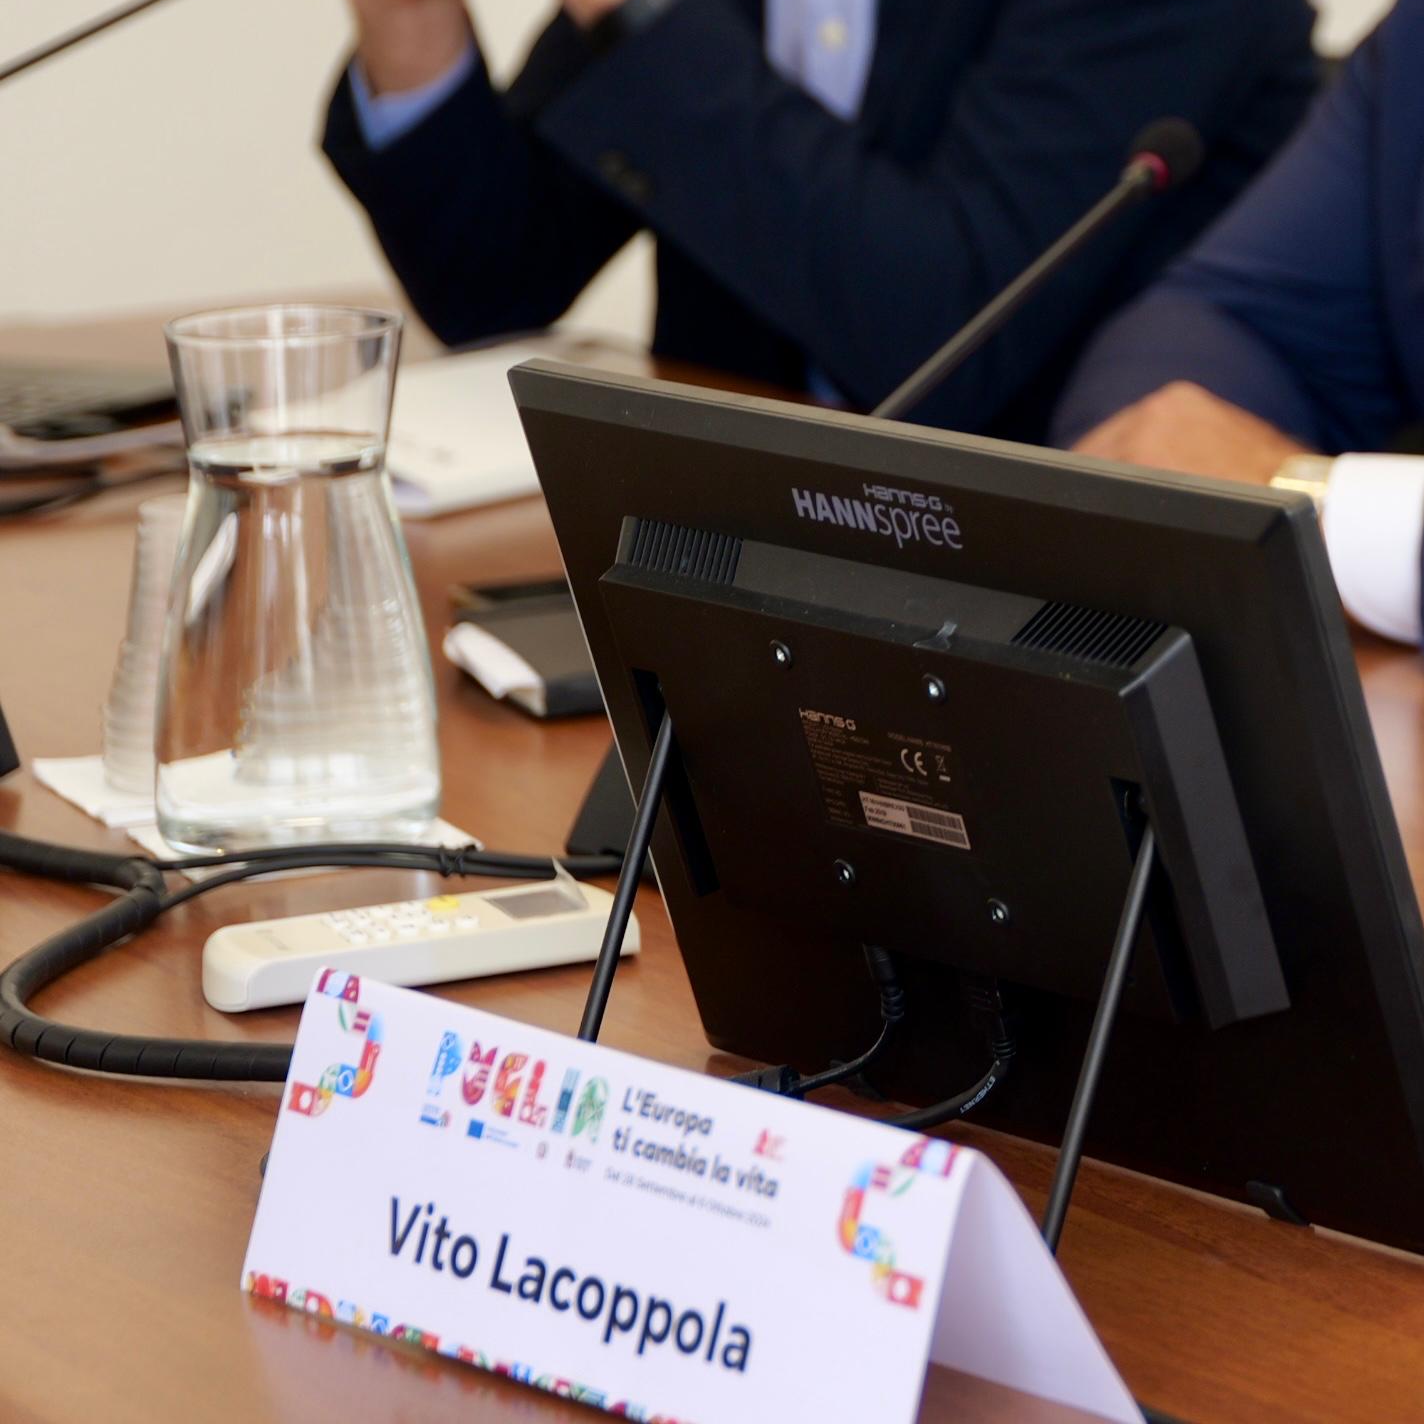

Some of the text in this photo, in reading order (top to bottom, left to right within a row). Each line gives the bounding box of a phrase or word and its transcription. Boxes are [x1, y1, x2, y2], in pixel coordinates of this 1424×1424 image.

[791, 487, 963, 549] HANNspree
[622, 1085, 714, 1136] L'Europa
[612, 1127, 779, 1198] ti cambia la vita
[389, 1195, 753, 1374] Vito Lacoppola
